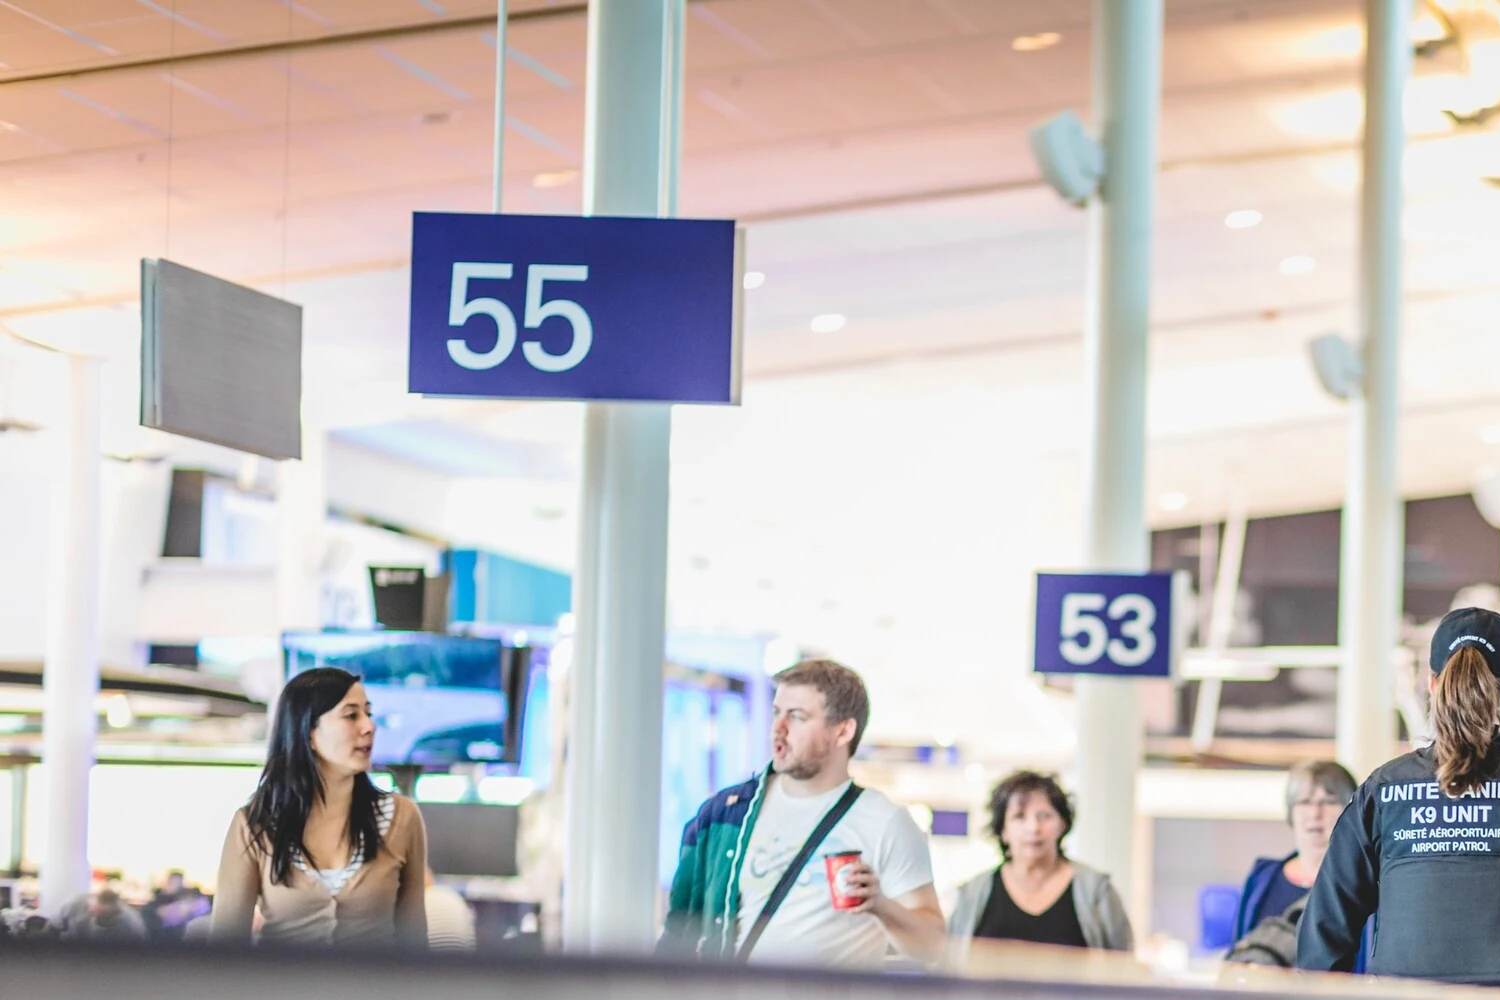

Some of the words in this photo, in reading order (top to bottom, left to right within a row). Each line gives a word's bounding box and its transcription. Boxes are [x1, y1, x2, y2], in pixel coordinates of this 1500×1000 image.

[446, 261, 594, 373] 55
[1058, 592, 1158, 667] 53
[1410, 806, 1437, 824] K9
[1442, 805, 1493, 823] UNIT
[1393, 827, 1427, 841] SÛRETÉ
[1411, 842, 1452, 853] AIRPORT
[1452, 841, 1491, 852] PATROL
